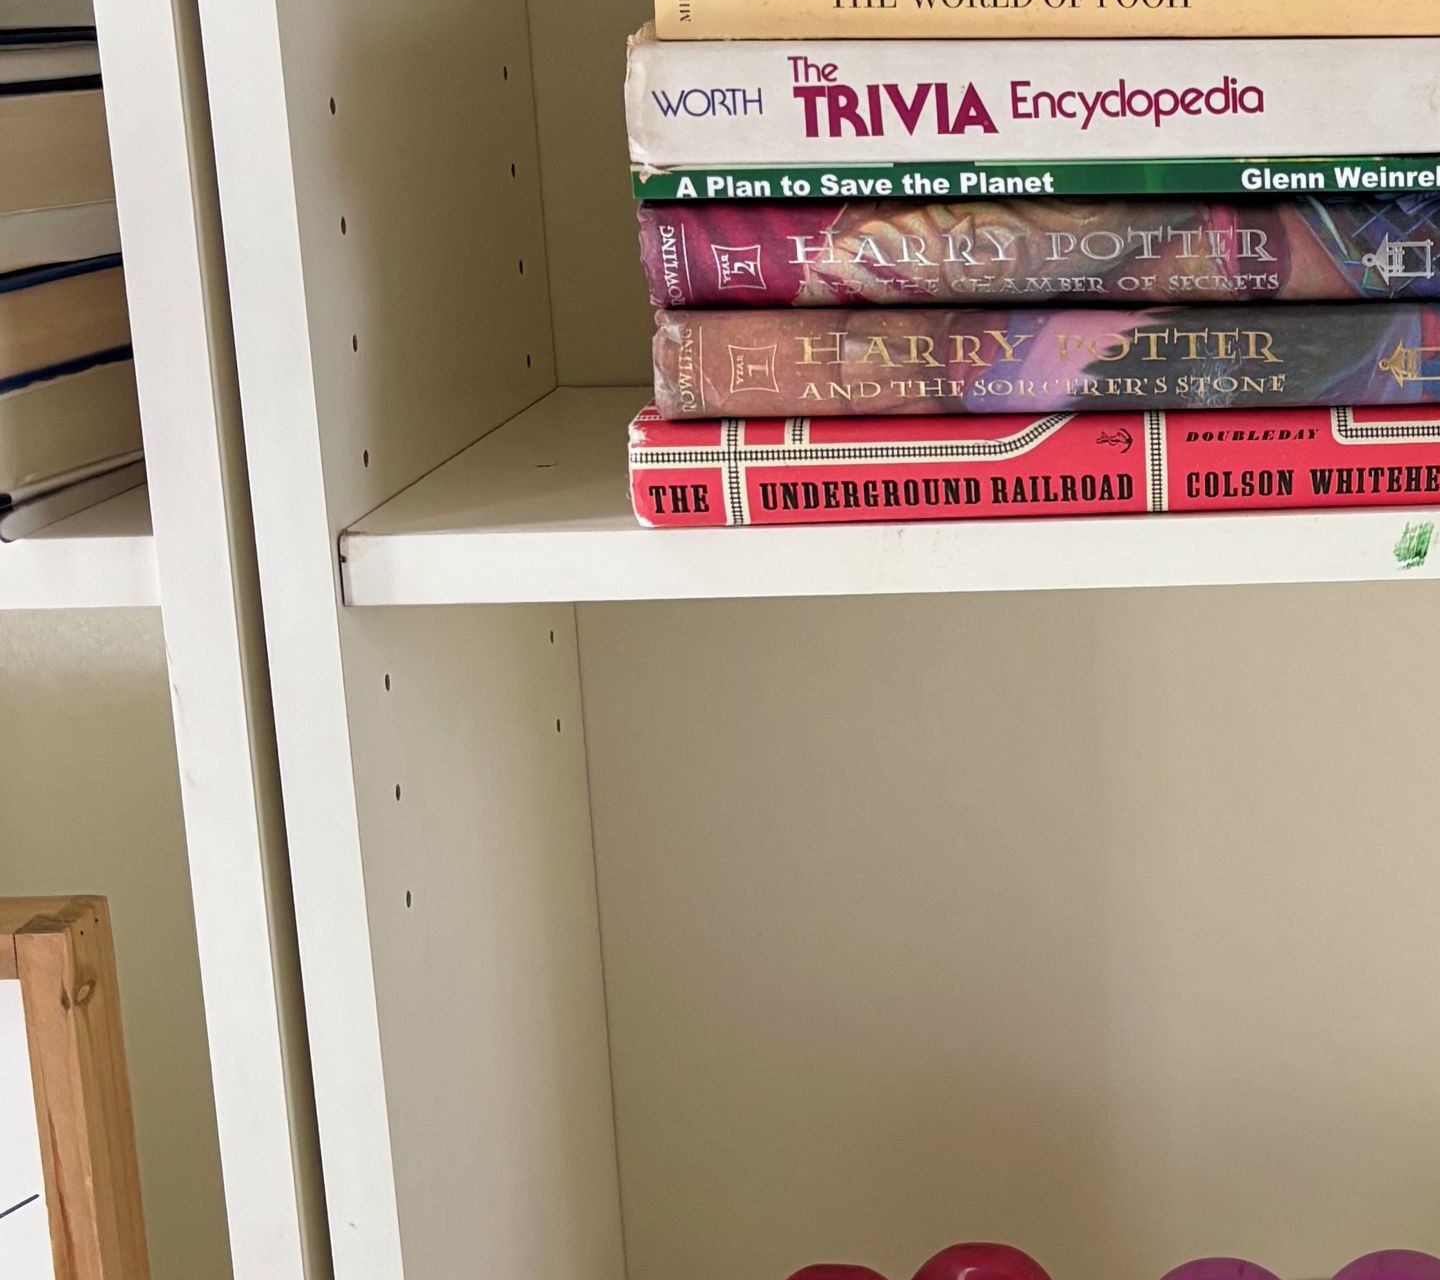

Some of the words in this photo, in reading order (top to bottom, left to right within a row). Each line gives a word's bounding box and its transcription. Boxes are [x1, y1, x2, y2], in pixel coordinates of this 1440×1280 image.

[787, 56, 839, 83] The
[651, 88, 763, 117] WORTH
[793, 82, 999, 138] TRIVIA
[1011, 75, 1264, 131] Encyclopedia
[676, 177, 697, 198] A
[707, 176, 771, 197] Plan
[780, 178, 811, 196] to
[820, 174, 893, 195] Save
[902, 174, 949, 194] the
[960, 172, 1054, 194] Planet
[1241, 169, 1325, 189] Glenn
[787, 228, 1035, 267] HARRY
[1045, 226, 1278, 263] POTTER
[720, 254, 731, 283] YEAR
[876, 277, 939, 292] THE
[952, 276, 1107, 294] CHAMBER
[1117, 275, 1157, 291] OF
[1169, 273, 1279, 294] SECRETS
[795, 330, 1034, 368] HARRY
[1056, 326, 1284, 363] POTTER
[679, 328, 697, 412] ROWLING
[736, 355, 745, 384] YEAR
[800, 380, 882, 401] AND
[891, 379, 966, 399] THE
[1176, 373, 1287, 395] STONE
[1185, 428, 1320, 443] DOUBLEDAY
[649, 485, 709, 514] THE
[759, 477, 981, 511] UNDERGROUND
[991, 474, 1133, 504] RAILROAD
[1186, 470, 1294, 499] COLSON
